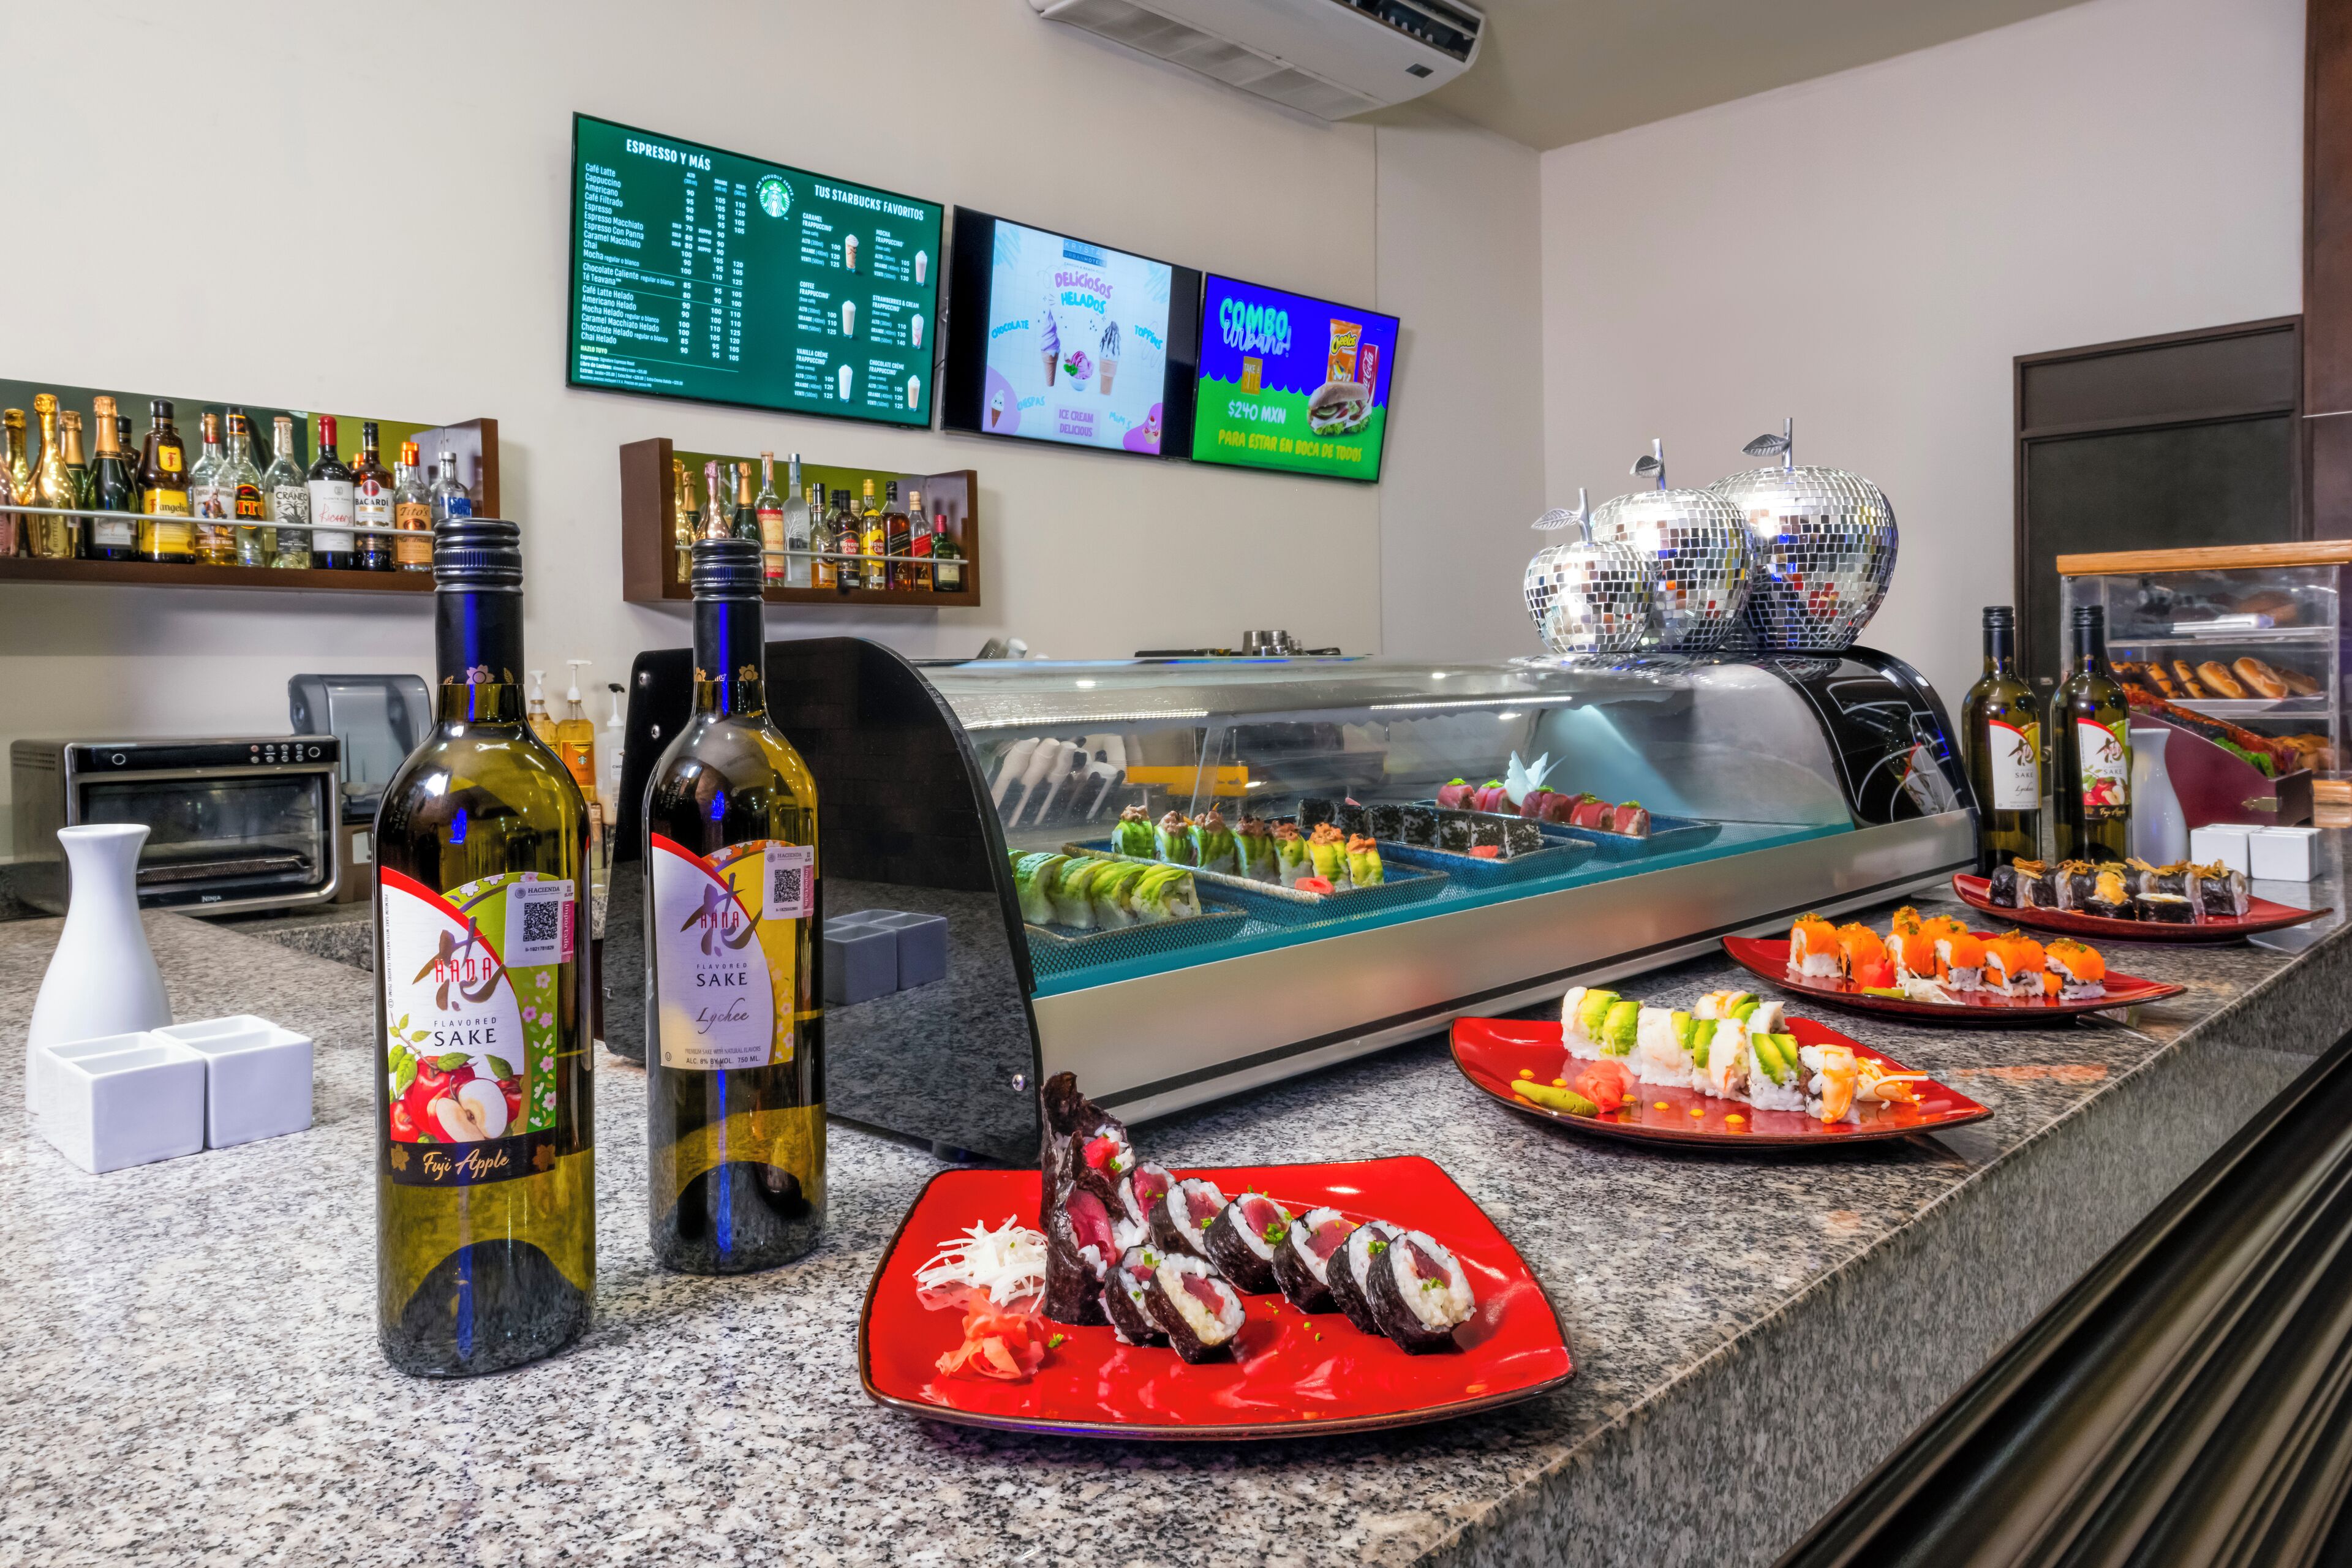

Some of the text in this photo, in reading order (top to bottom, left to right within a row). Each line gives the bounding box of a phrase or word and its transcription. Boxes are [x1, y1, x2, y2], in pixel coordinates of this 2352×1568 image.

[627, 139, 710, 171] ESPRESSO Y MÁS
[586, 163, 616, 177] Café Latte
[586, 173, 621, 188] Cappuccino
[783, 180, 794, 196] SERVE
[585, 183, 618, 197] Americano
[585, 192, 623, 207] Café Filtrado
[815, 185, 830, 199] TUS
[883, 202, 924, 221] FAVORITOS
[585, 202, 612, 215] Espresso
[584, 211, 644, 230] Espresso Macchiato
[802, 213, 823, 222] CARAMEL
[584, 221, 644, 239] Espresso Con Panna
[876, 229, 891, 238] MOCHA
[584, 230, 641, 249] Caramel Macchiato
[584, 239, 597, 249] Chai
[584, 249, 603, 260] Mocha
[582, 272, 590, 281] Té
[583, 262, 639, 280] Chocolate Caliente
[582, 285, 634, 301] Café Latte Helado
[582, 295, 636, 311] Americano Helado
[1061, 292, 1106, 315] HELADOS
[582, 304, 624, 318] Mocha Helado
[1219, 297, 1288, 340] COMBO
[581, 313, 659, 333] Caramel Macchiato Helado
[581, 322, 633, 337] Chocolate Helado
[992, 320, 1029, 339] CHOCOLATE
[581, 331, 617, 344] Chai Helado
[1331, 331, 1357, 355] Cheetos
[796, 349, 813, 357] VANILLA
[869, 360, 891, 369] CHOCOLATE
[1059, 409, 1093, 423] ICE CREAM
[1228, 399, 1286, 424] $240 MXN
[1060, 423, 1093, 437] DELICIOUS
[1219, 429, 1245, 447] PARA
[1248, 433, 1277, 451] ESTAR
[1280, 438, 1292, 453] EN
[1295, 440, 1319, 456] BOCA
[1322, 443, 1333, 458] DE
[355, 497, 389, 507] BACARDÍ
[400, 507, 428, 516] Tito's
[701, 911, 739, 929] HANA
[435, 957, 492, 983] HANA
[696, 973, 748, 987] SAKE
[434, 1017, 497, 1027] FLAVORED
[696, 998, 749, 1034] Lychee
[434, 1028, 497, 1047] SAKE
[423, 1148, 510, 1181] Fuji Apple
